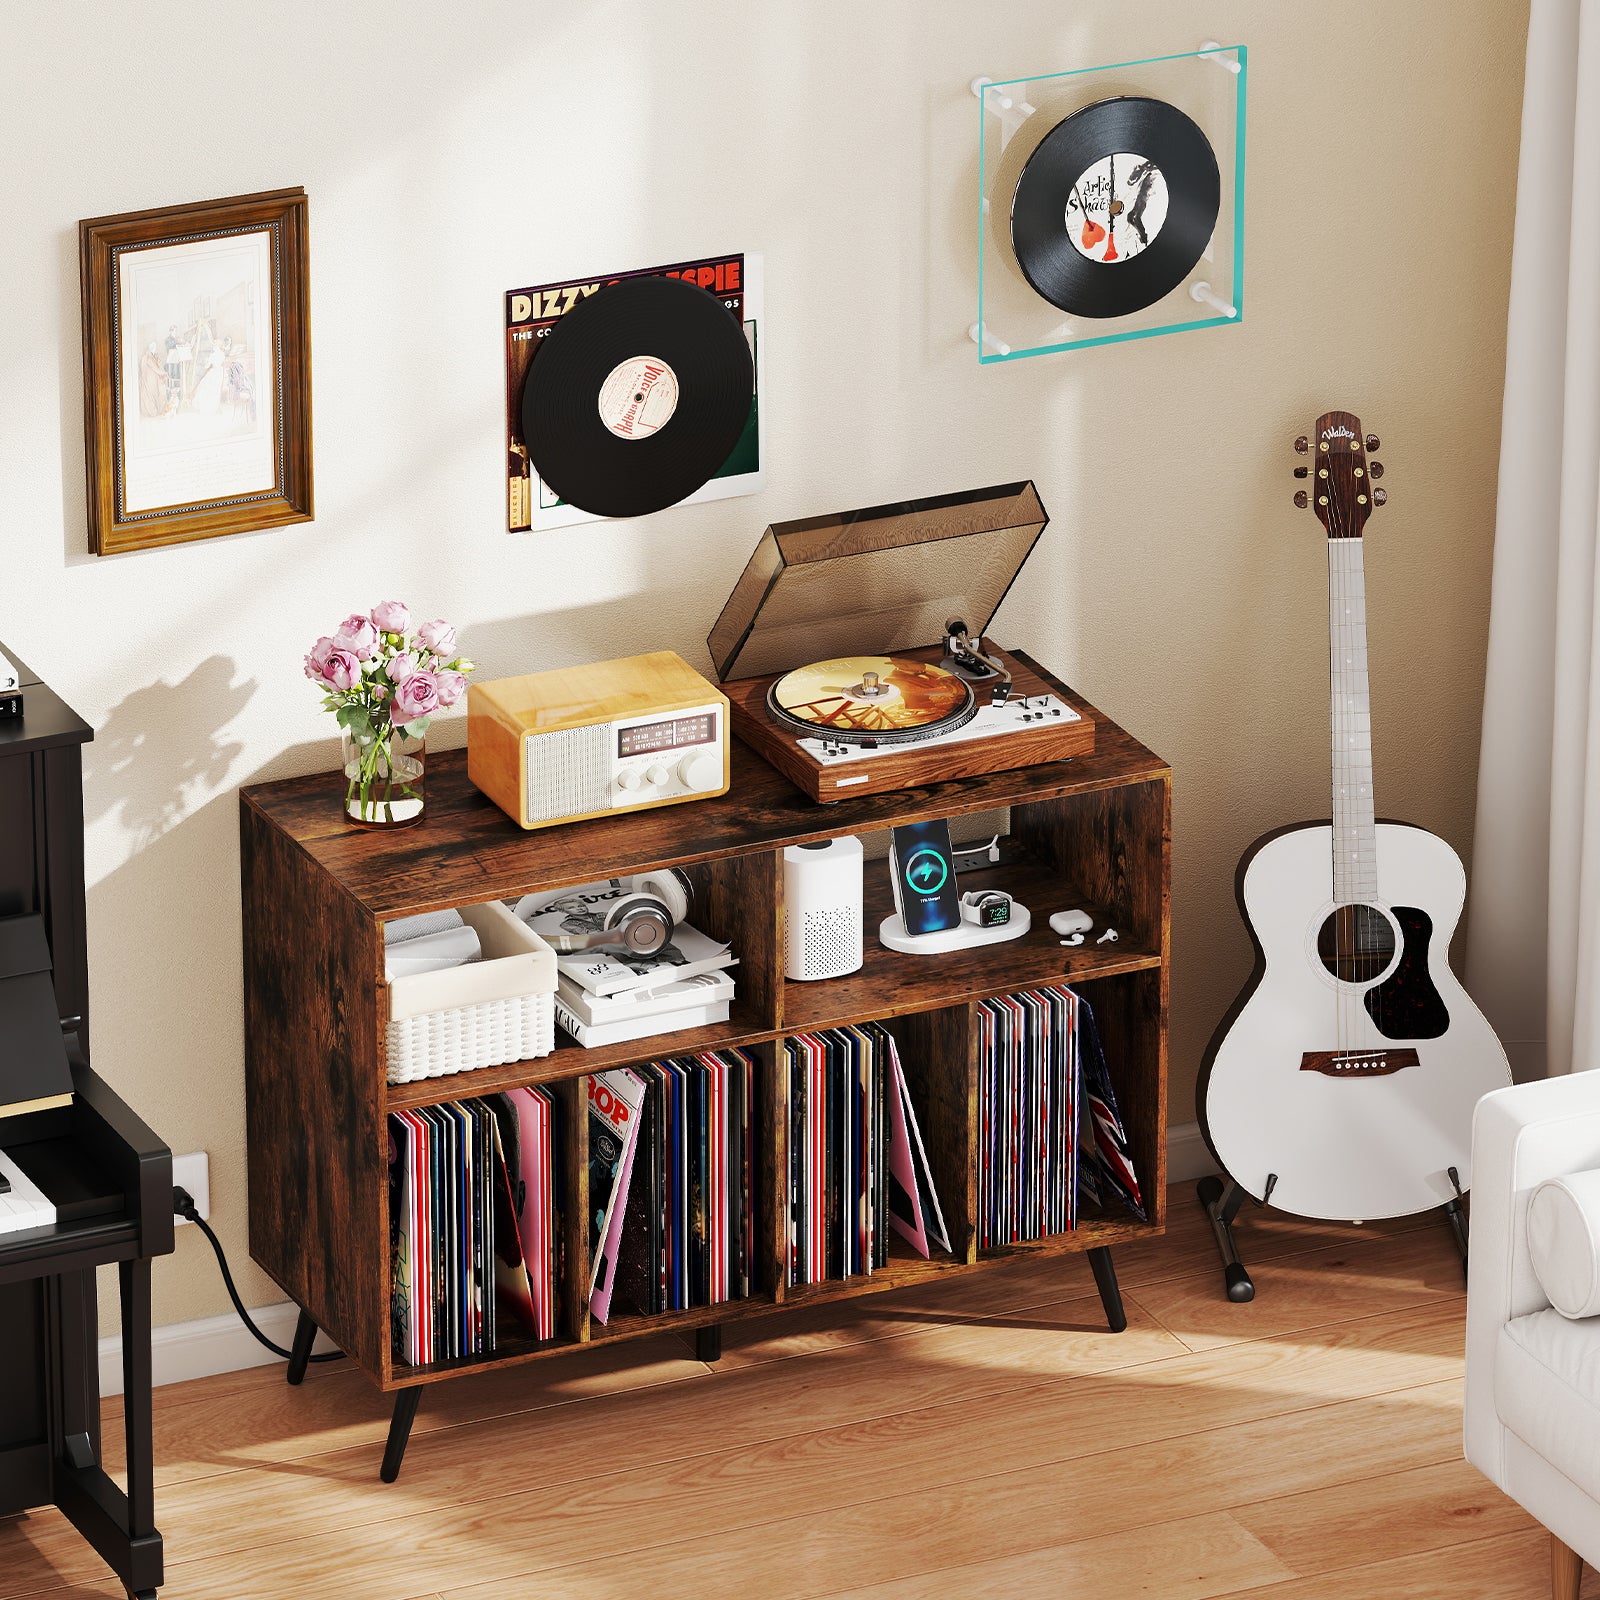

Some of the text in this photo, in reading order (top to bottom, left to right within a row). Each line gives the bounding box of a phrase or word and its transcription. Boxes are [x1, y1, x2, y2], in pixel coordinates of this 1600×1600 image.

[511, 284, 601, 323] DIZZY
[512, 330, 533, 342] THE
[613, 404, 638, 435] GRAPH
[1321, 425, 1355, 440] Walden
[989, 907, 1007, 918] 7:29
